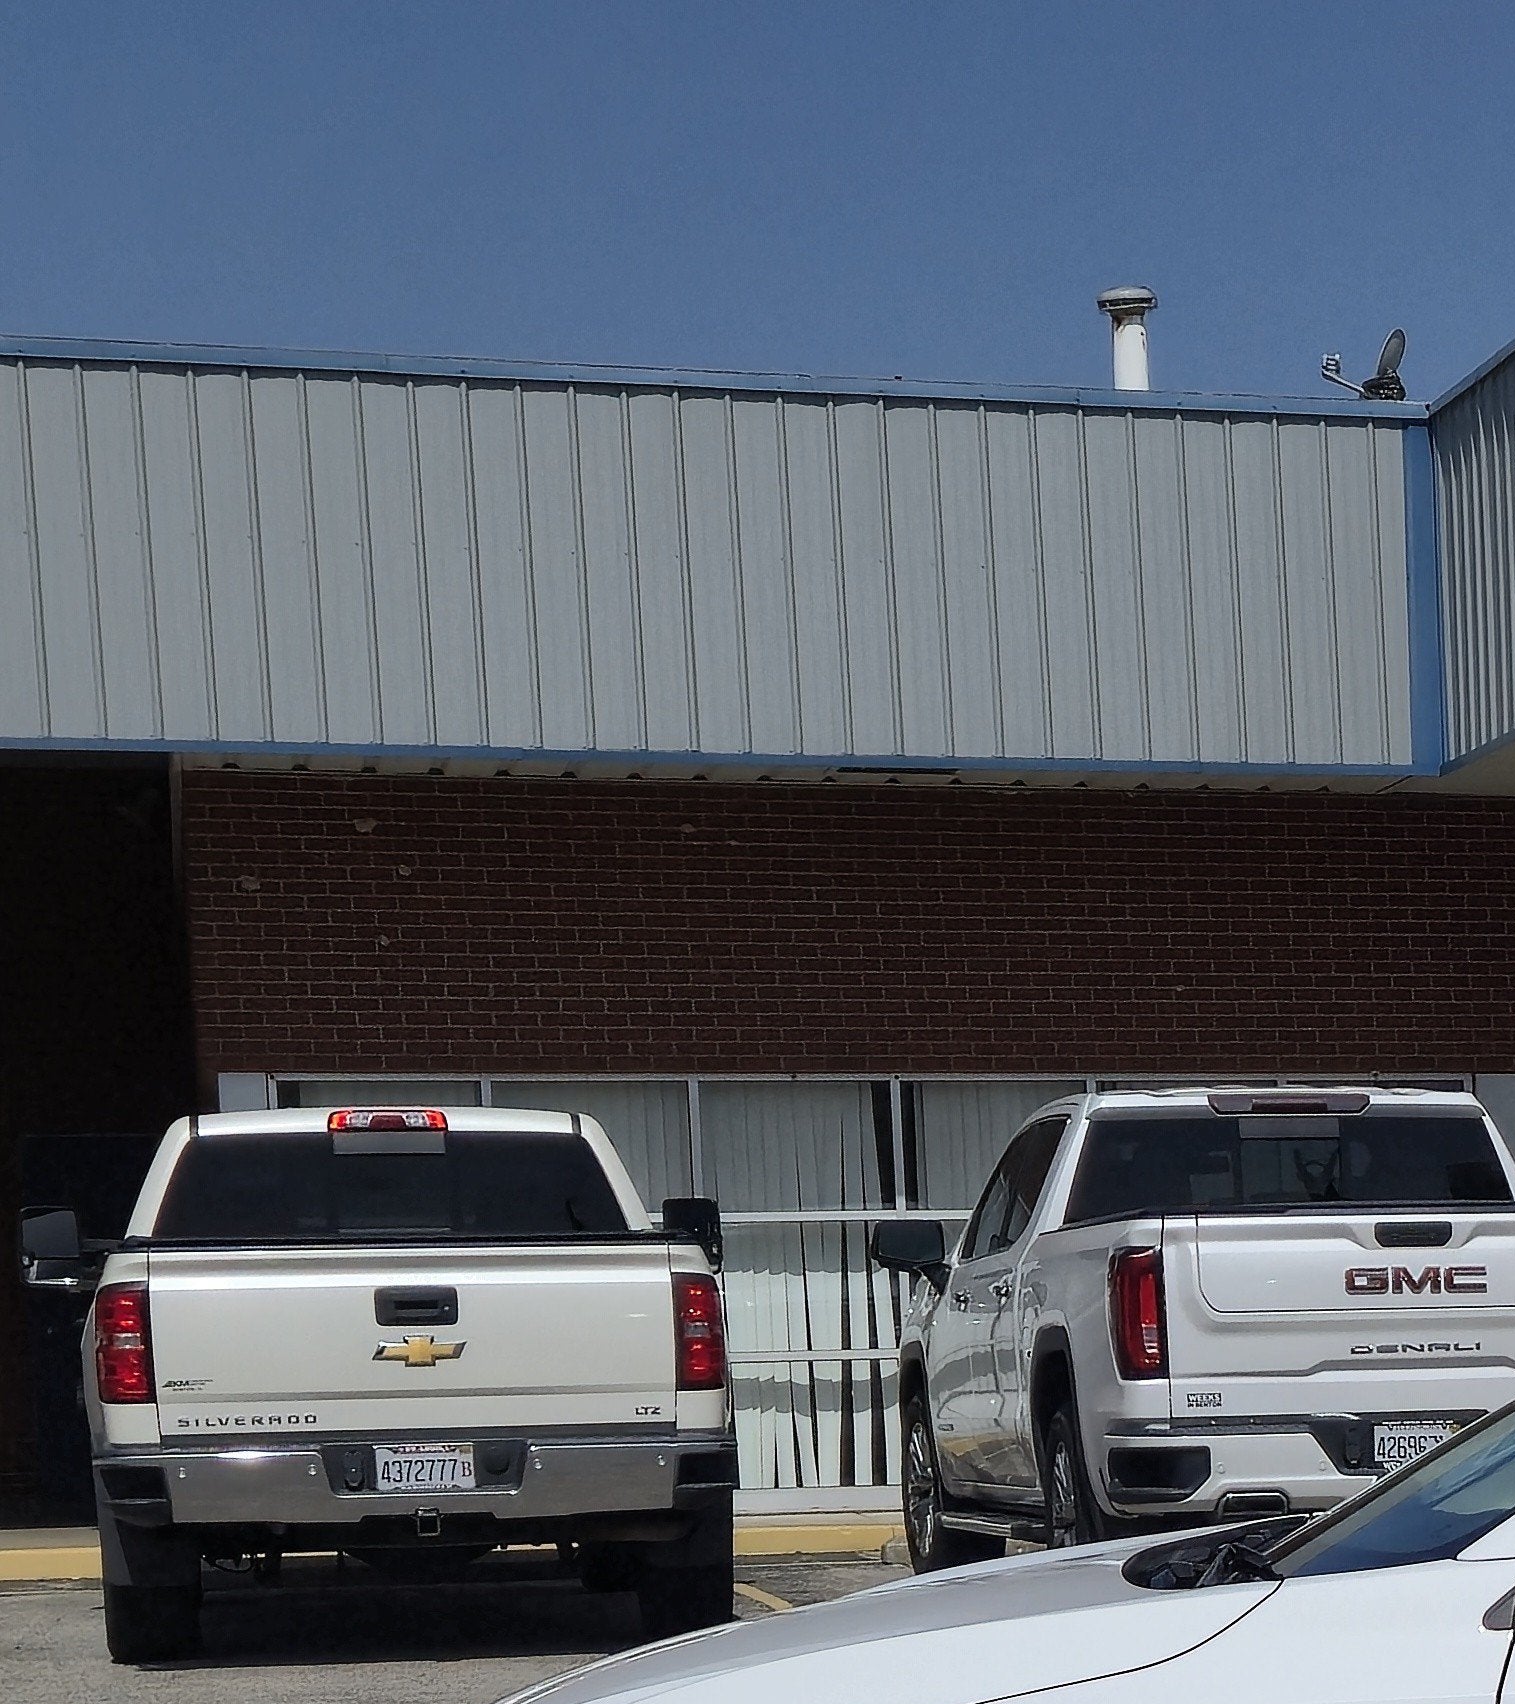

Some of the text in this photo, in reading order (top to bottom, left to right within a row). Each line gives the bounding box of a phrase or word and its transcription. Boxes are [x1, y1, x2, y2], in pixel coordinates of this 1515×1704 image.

[1344, 1265, 1488, 1296] GMC
[1350, 1341, 1482, 1355] DENALI
[1188, 1394, 1221, 1402] WEEKS
[635, 1406, 661, 1416] LTZ
[177, 1414, 318, 1428] SILVERADO
[381, 1458, 473, 1483] 4372777 B
